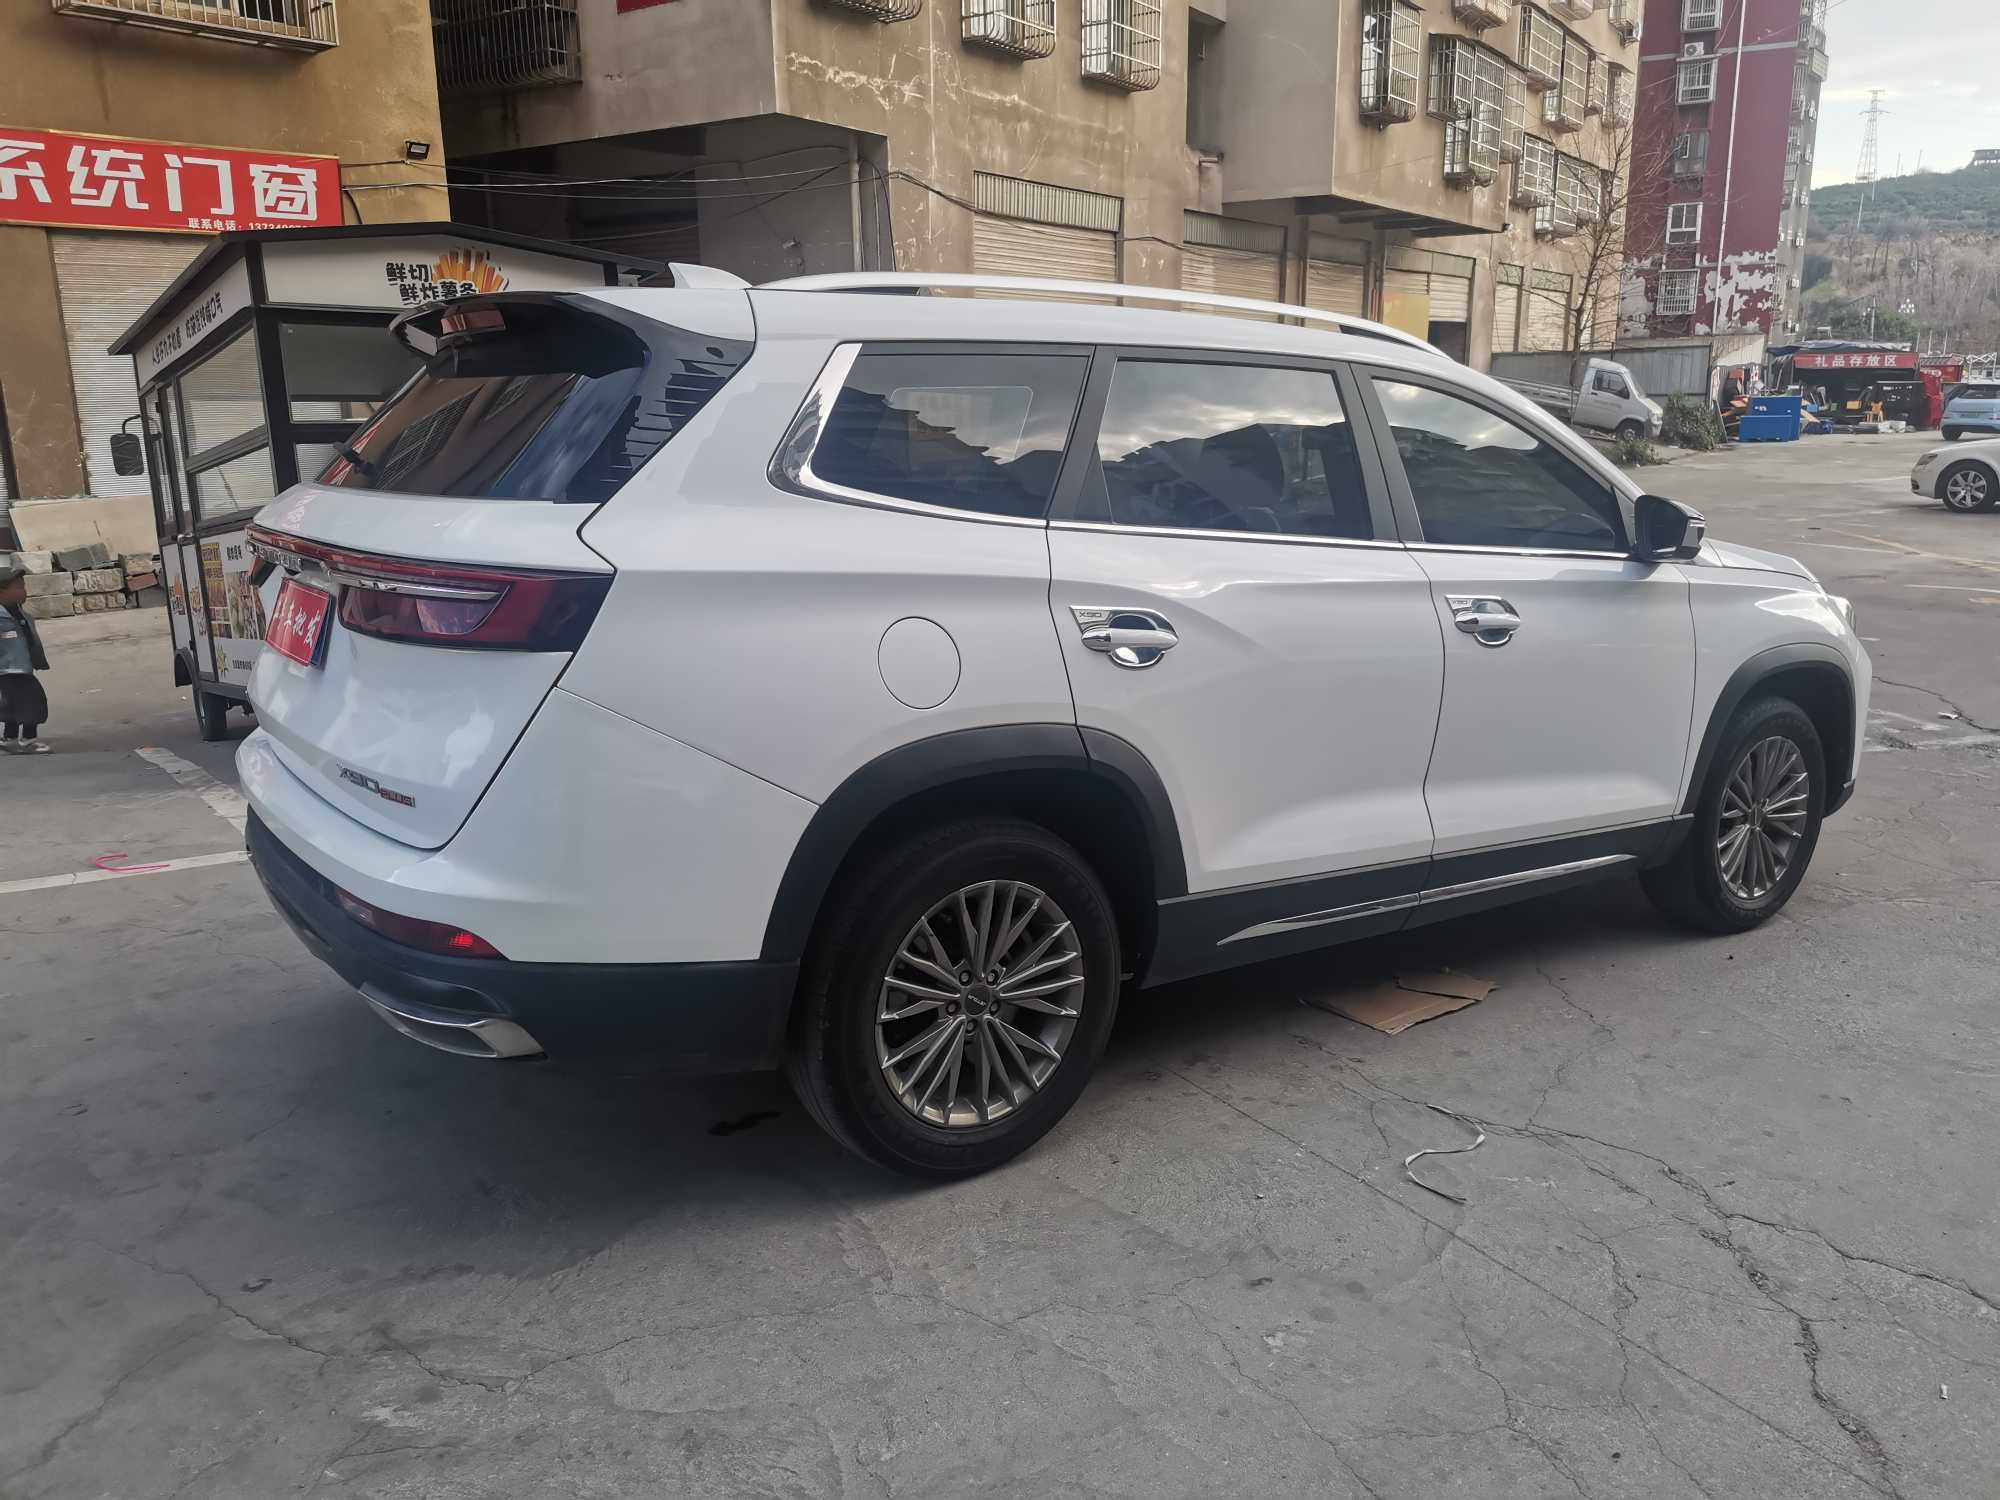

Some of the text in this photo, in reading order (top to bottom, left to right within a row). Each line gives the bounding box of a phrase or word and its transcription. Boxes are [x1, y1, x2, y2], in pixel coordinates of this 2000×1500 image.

[0, 138, 318, 222] 系统门窗
[386, 262, 430, 283] 鲜切
[399, 280, 479, 302] 鲜炸薯条
[1815, 353, 1898, 368] 礼品存放区
